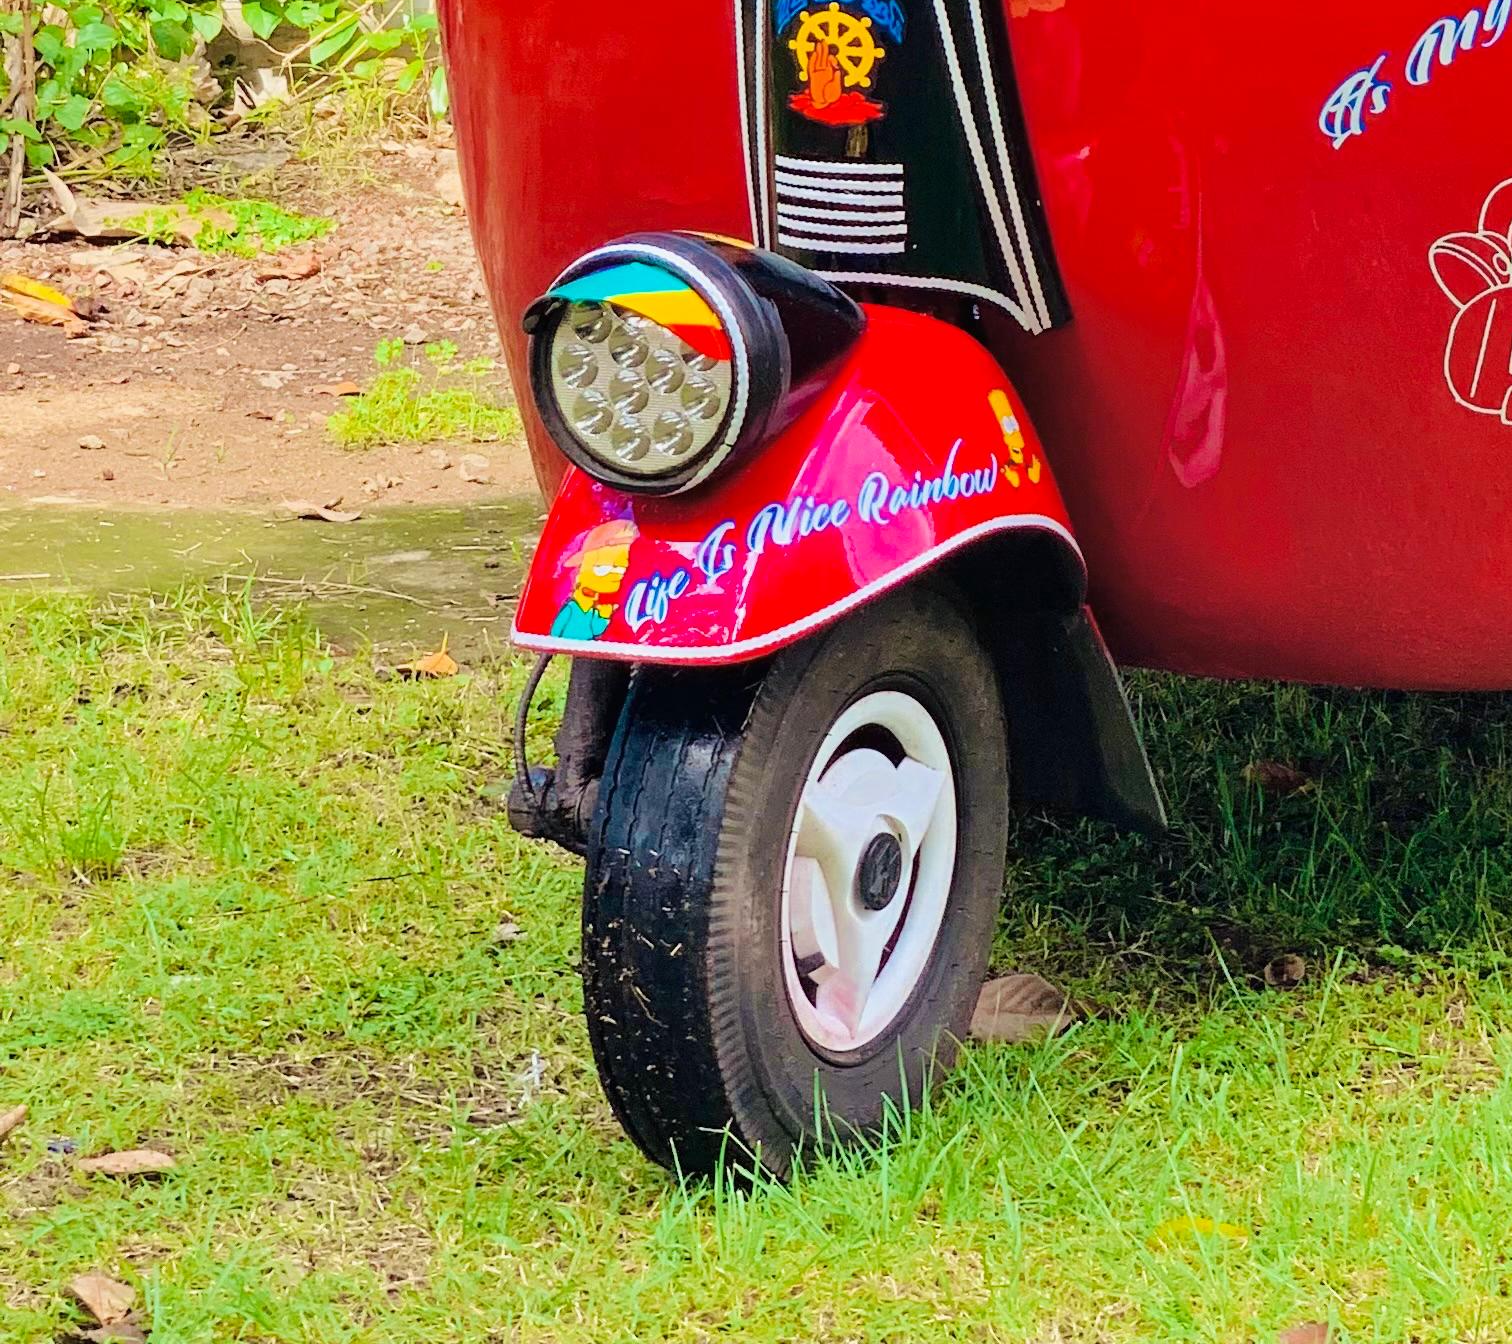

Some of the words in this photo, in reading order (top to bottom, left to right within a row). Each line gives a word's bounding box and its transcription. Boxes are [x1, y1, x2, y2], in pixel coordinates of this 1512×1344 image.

[624, 567, 692, 634] Life
[696, 519, 738, 587] Is
[746, 496, 851, 554] Nice
[857, 438, 999, 526] Rainbow
